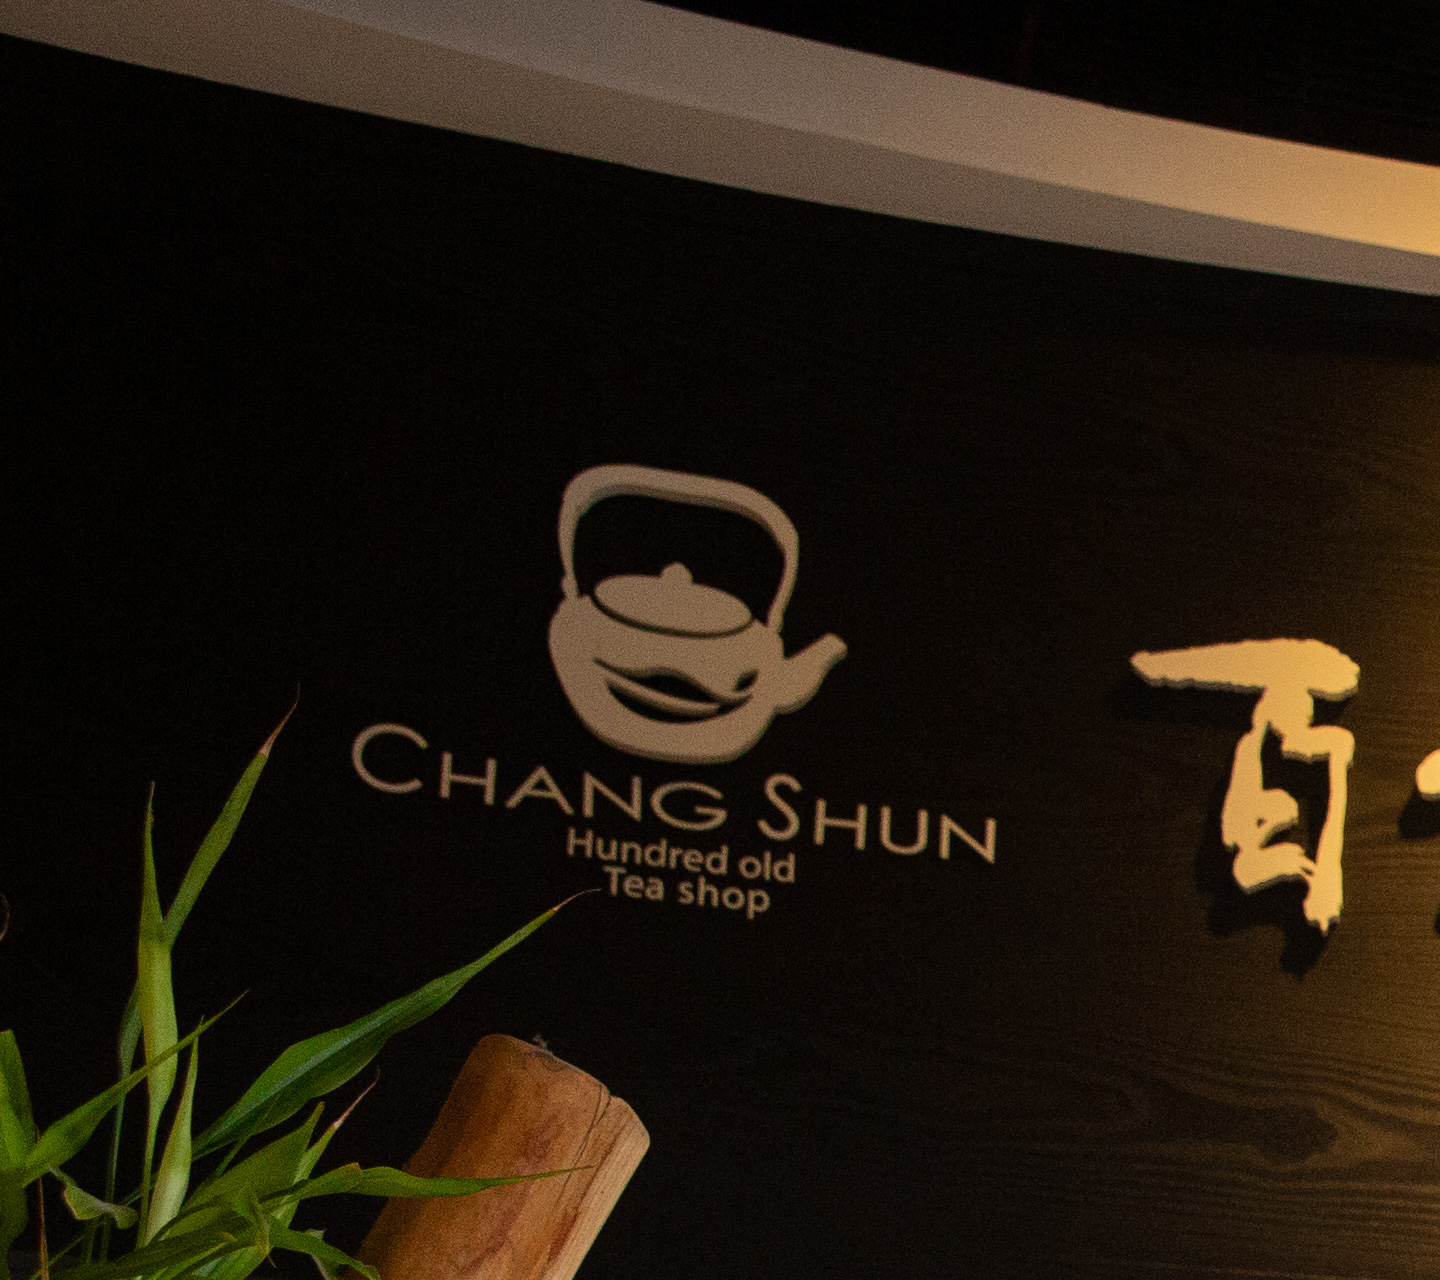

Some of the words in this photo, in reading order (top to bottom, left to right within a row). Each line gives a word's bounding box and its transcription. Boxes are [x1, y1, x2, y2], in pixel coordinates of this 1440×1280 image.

[351, 723, 728, 832] CHANG
[757, 773, 997, 865] SHUN
[566, 827, 729, 880] Hundred
[738, 846, 796, 884] old
[602, 867, 664, 901] Tea
[678, 875, 770, 919] shop
